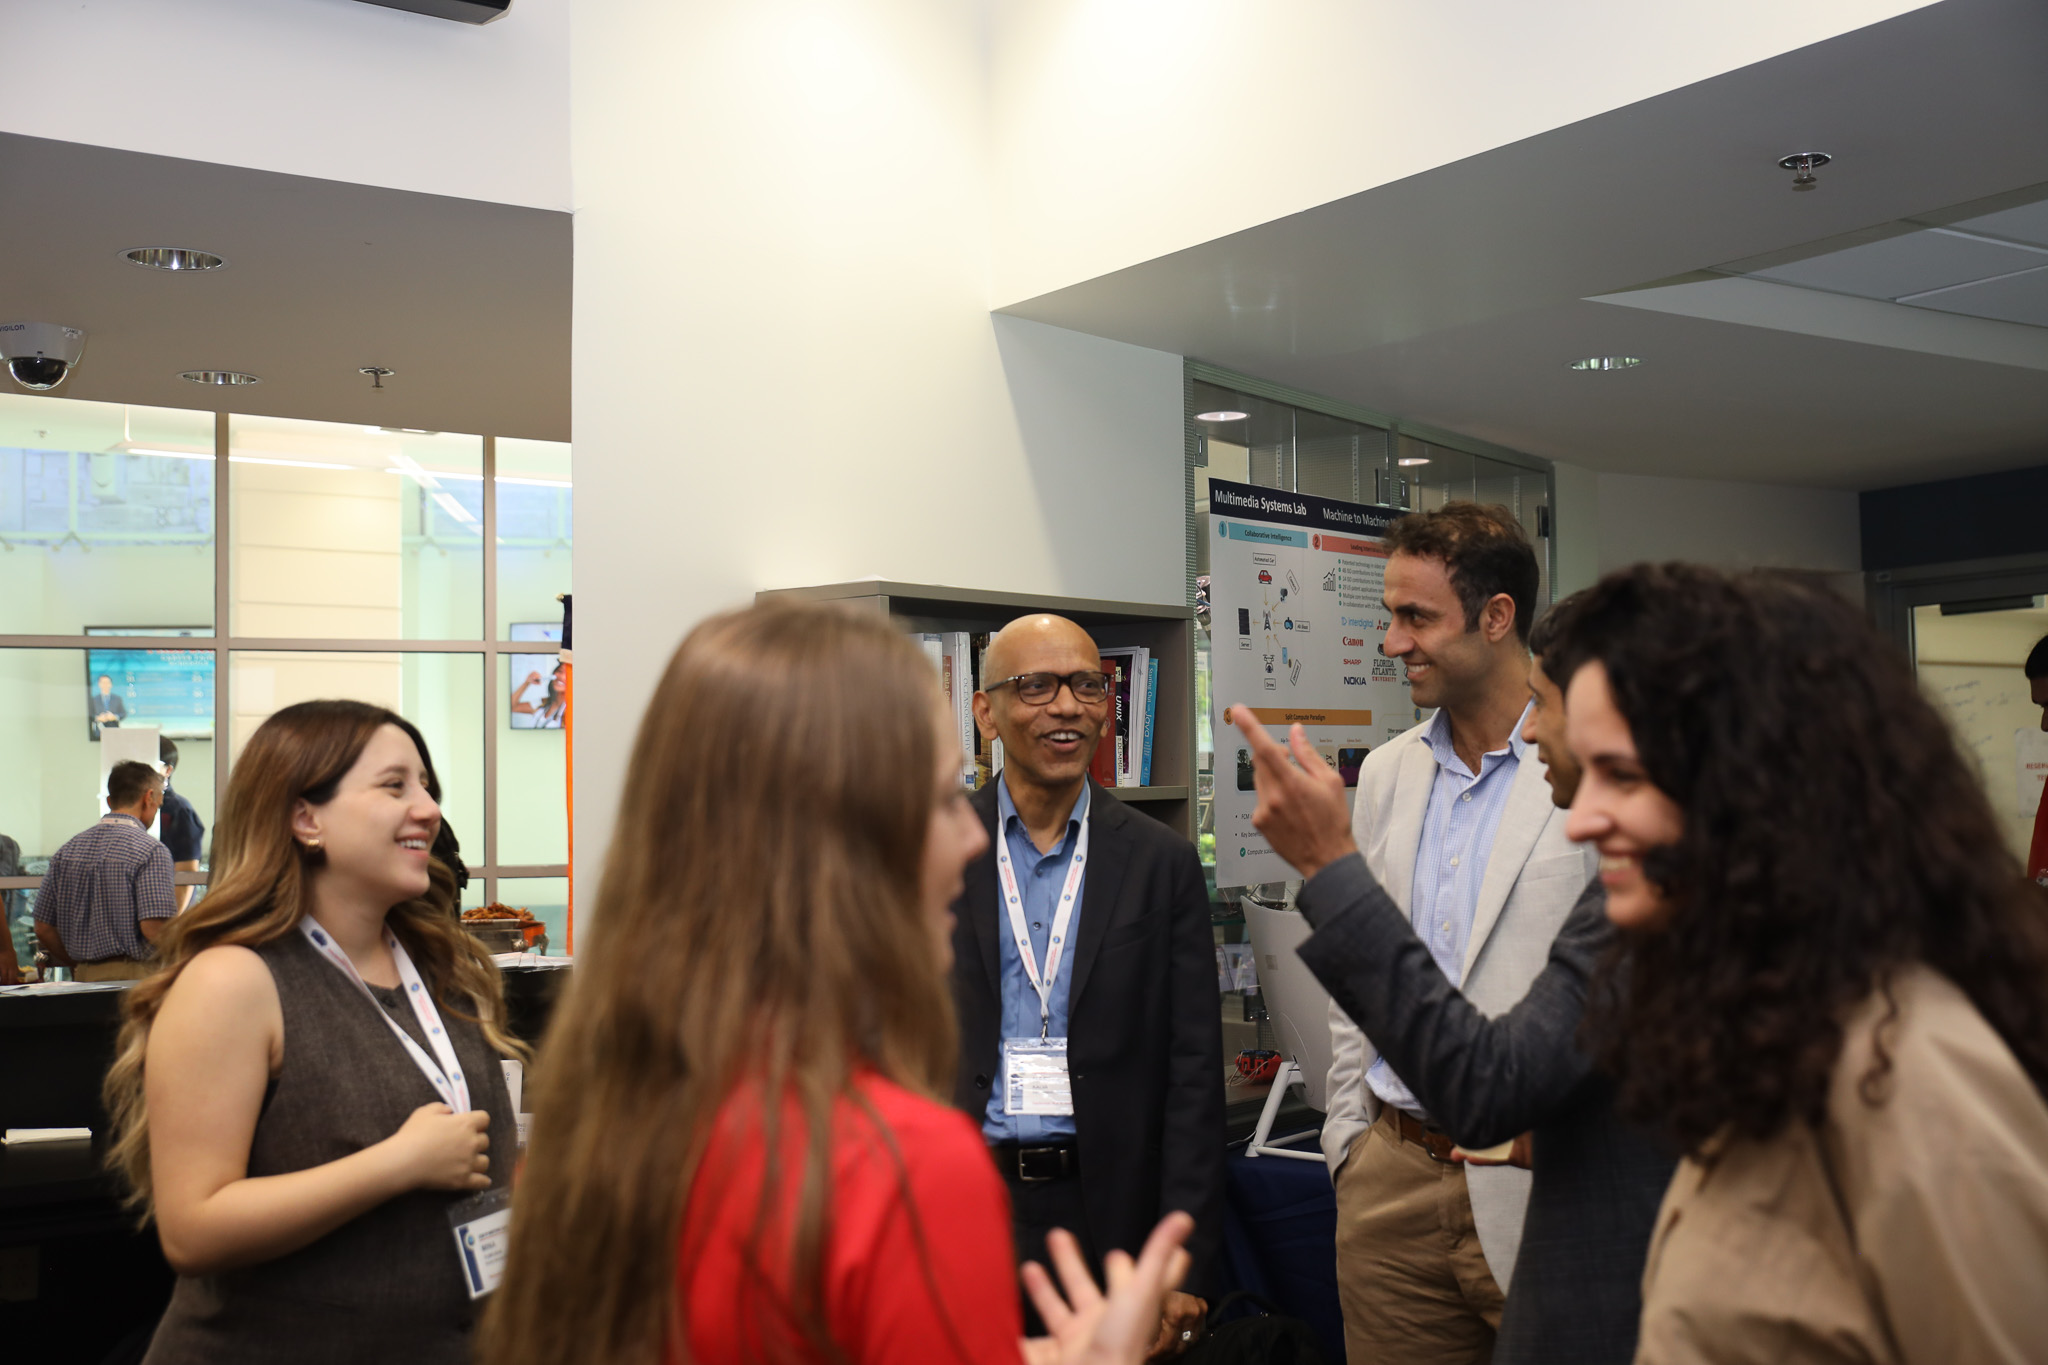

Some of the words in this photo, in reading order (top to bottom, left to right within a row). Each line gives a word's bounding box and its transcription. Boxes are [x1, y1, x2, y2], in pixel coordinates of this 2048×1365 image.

[1215, 490, 1259, 509] Multimedia
[1261, 497, 1292, 514] Systems
[1293, 502, 1307, 516] Lab
[1323, 507, 1353, 523] Machine
[1353, 513, 1362, 525] to
[1362, 514, 1390, 528] Machine
[1244, 529, 1270, 539] Collaborative
[1271, 533, 1292, 542] Intelligence
[1342, 636, 1364, 647] Canon
[1373, 659, 1395, 668] FLORIDA
[1371, 667, 1397, 676] ATLANTIC
[1343, 676, 1367, 686] NOKIA
[962, 677, 971, 752] OCEANOGRAPHY
[1285, 713, 1293, 721] Split
[1309, 714, 1326, 722] Paradigm
[1144, 711, 1152, 738] Java
